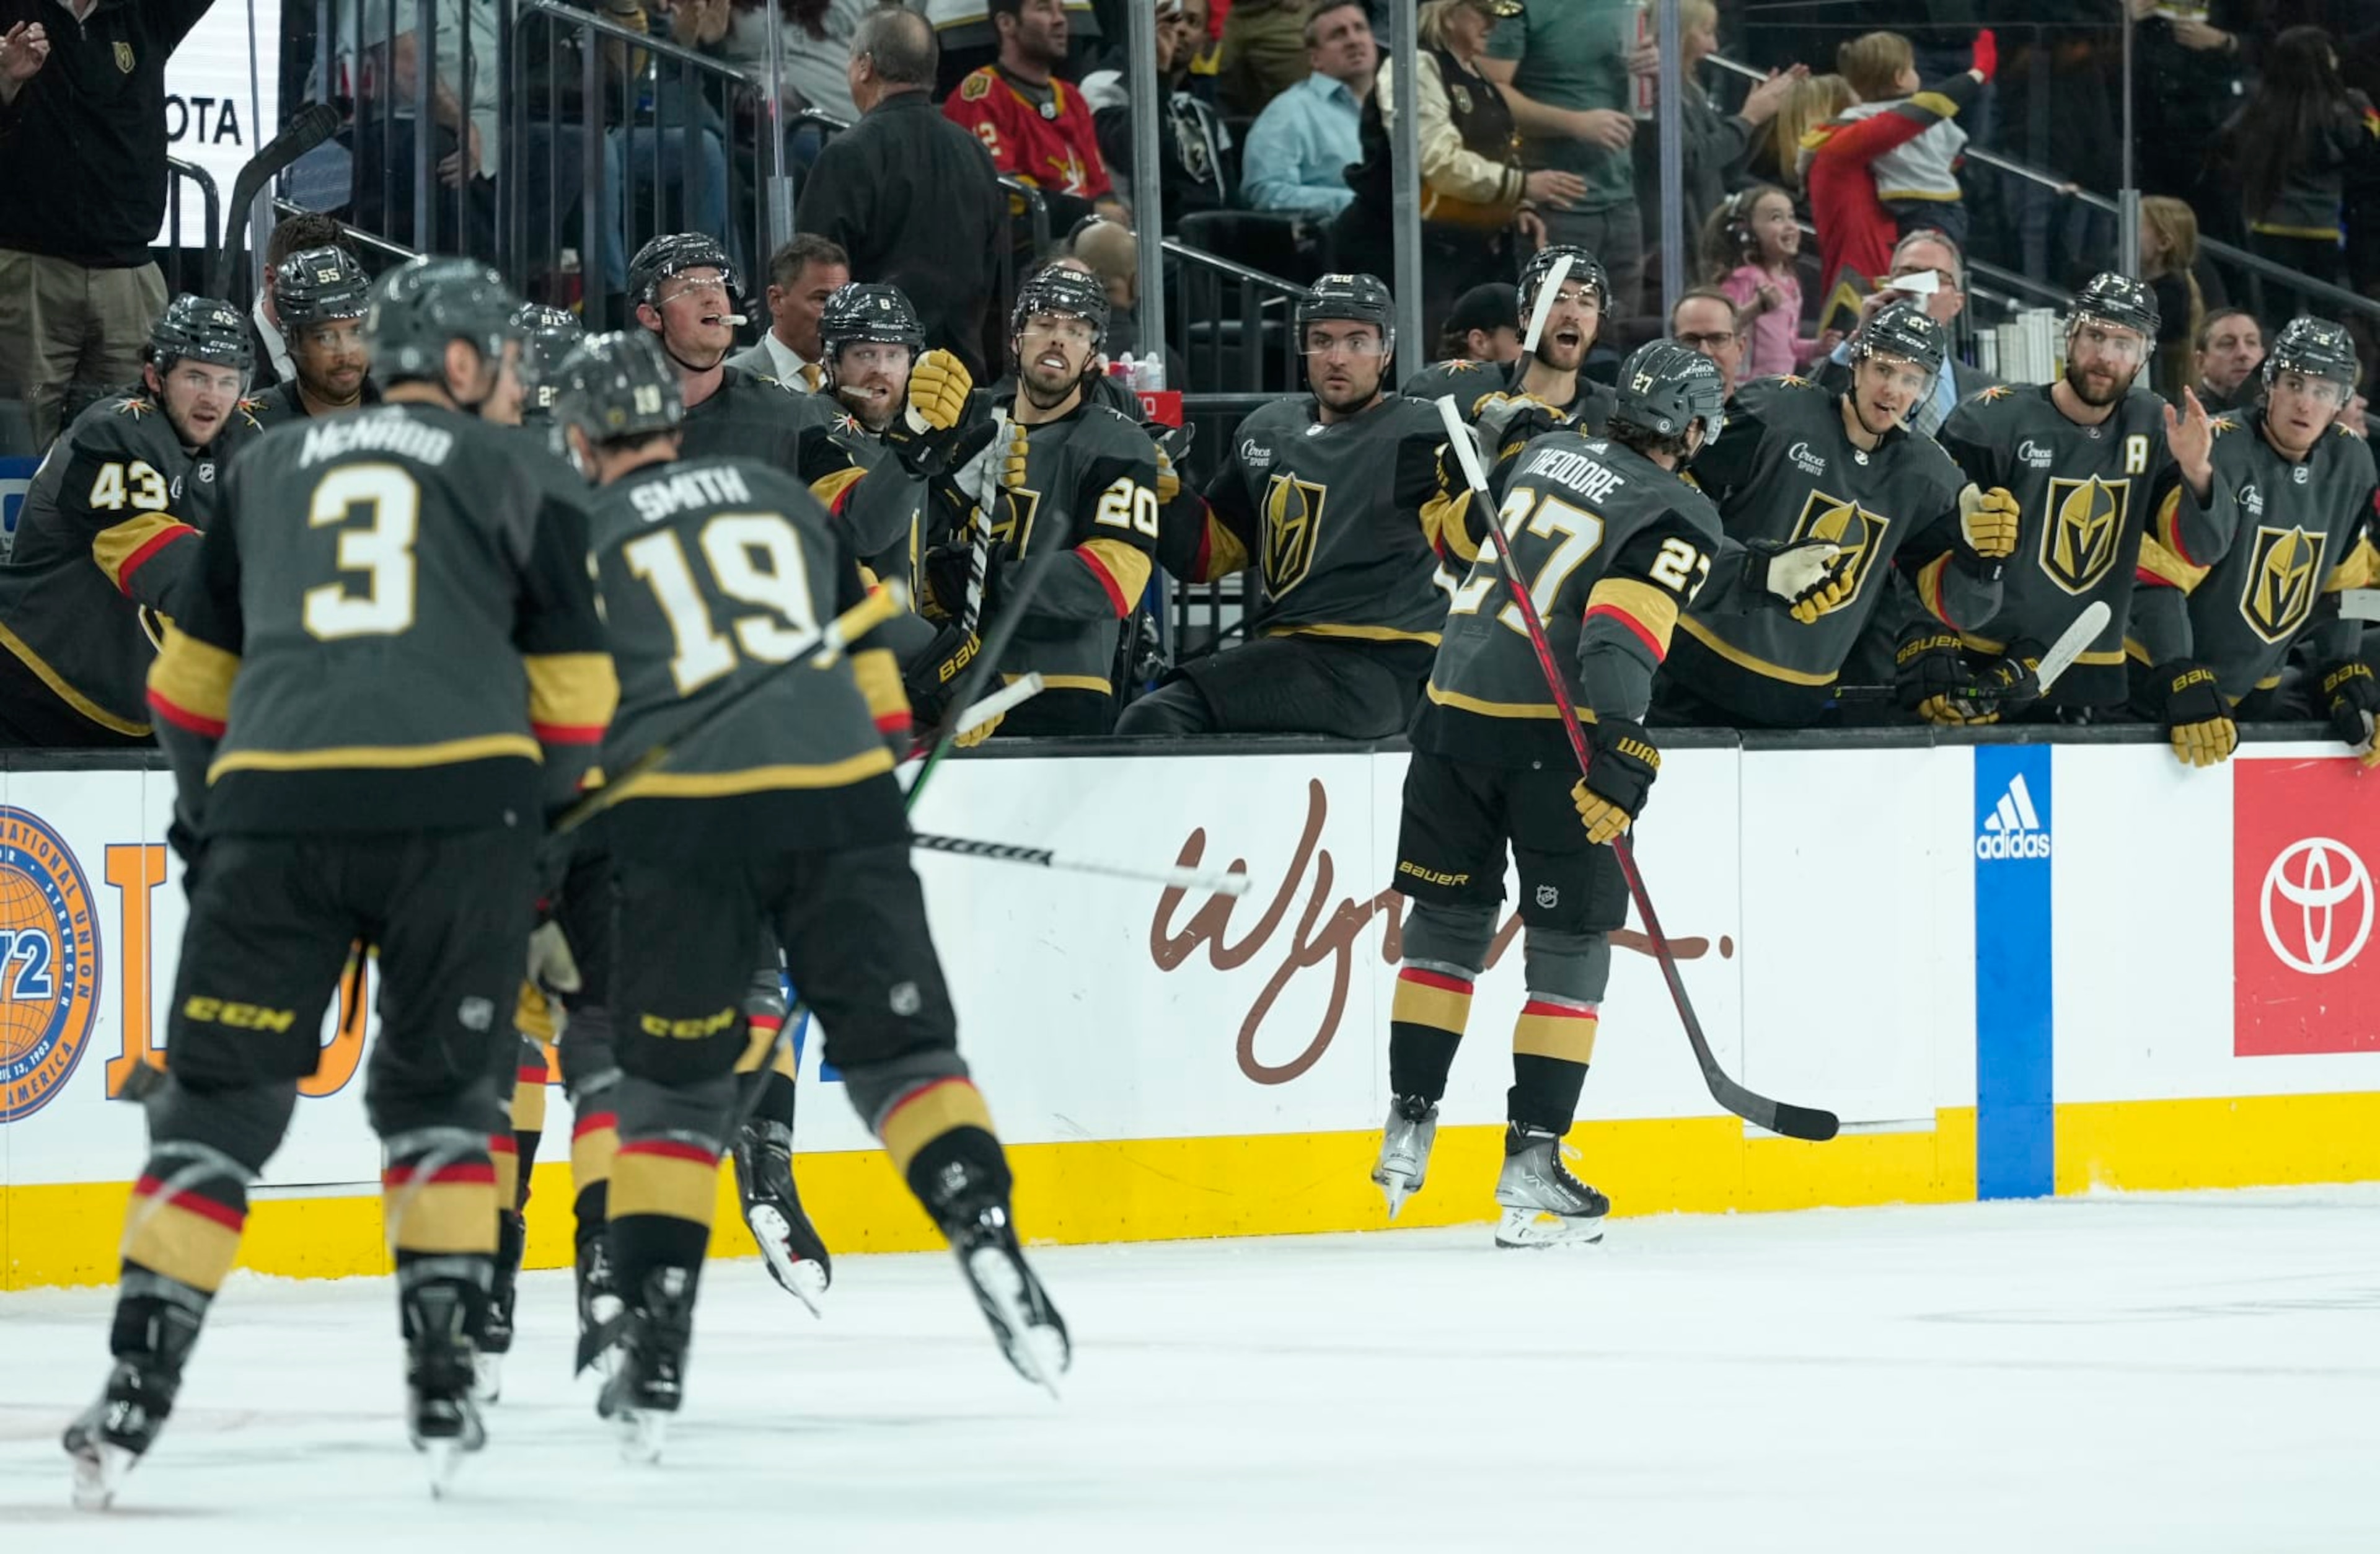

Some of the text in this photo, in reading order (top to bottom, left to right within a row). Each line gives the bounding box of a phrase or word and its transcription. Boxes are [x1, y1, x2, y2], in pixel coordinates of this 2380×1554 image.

[317, 268, 340, 283] 55
[879, 298, 891, 310] 8
[1631, 370, 1654, 395] 27
[1523, 448, 1625, 504] THEODORE
[1788, 442, 1826, 467] Circa
[1797, 460, 1824, 477] SPORTS
[2125, 435, 2148, 474] A
[90, 460, 170, 511] 43
[629, 464, 751, 523] SMITH
[1095, 477, 1158, 539] 20
[302, 462, 420, 642] 3
[1448, 487, 1605, 637] 27
[622, 512, 834, 698] 19
[1976, 828, 2050, 860] adidas
[1398, 860, 1470, 887] BAUER
[45, 882, 74, 1008] STRENGTH
[74, 909, 92, 999] UNION
[183, 996, 297, 1033] CCM
[8, 1041, 73, 1106] AMERICA
[29, 1040, 50, 1066] 1903
